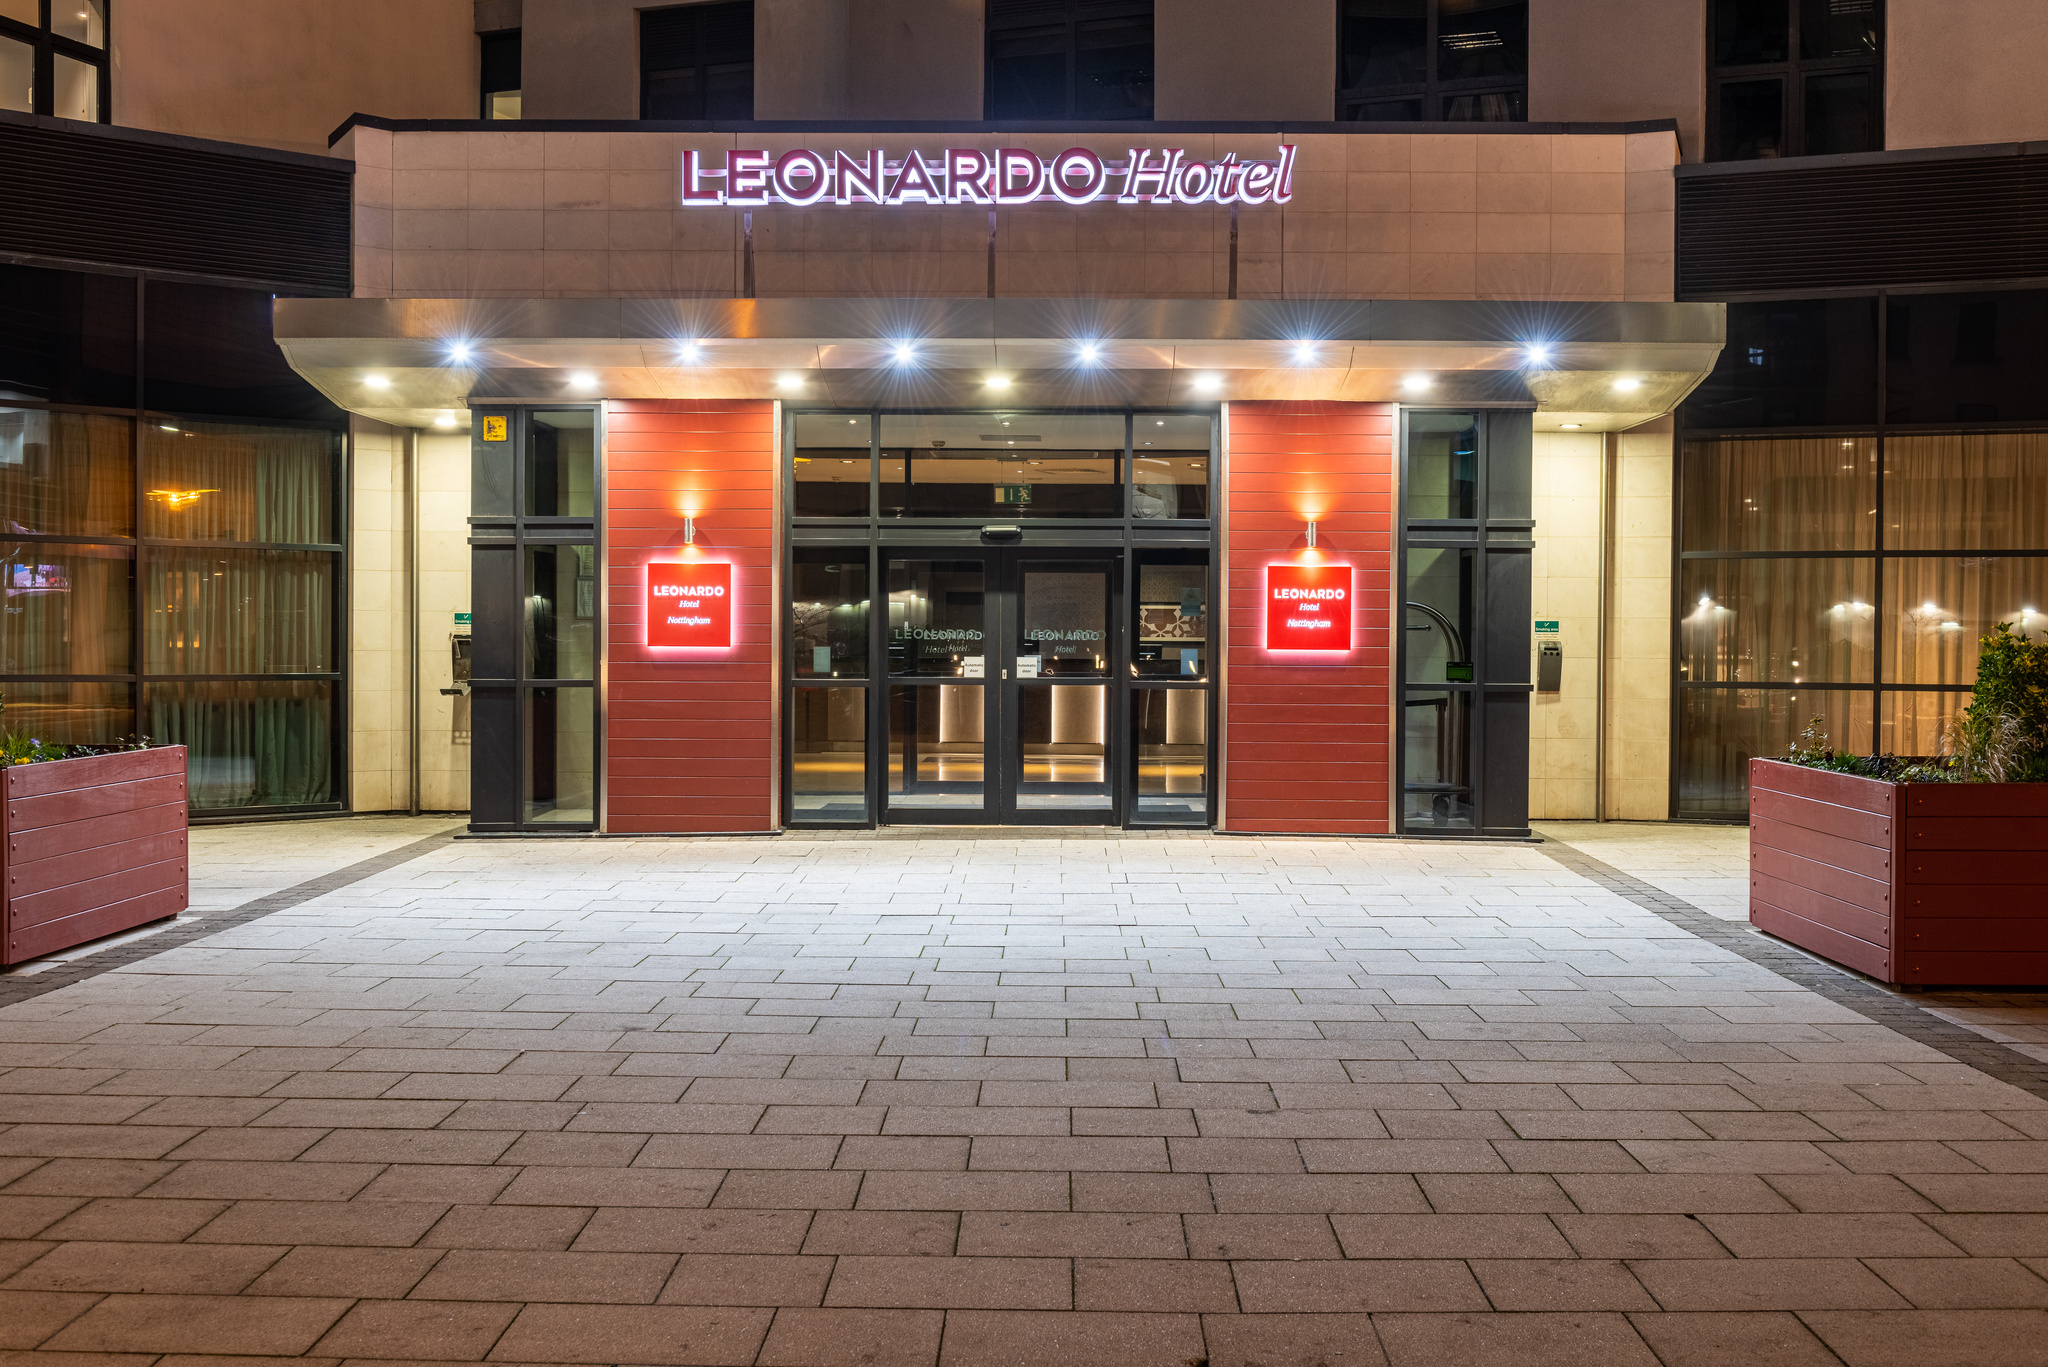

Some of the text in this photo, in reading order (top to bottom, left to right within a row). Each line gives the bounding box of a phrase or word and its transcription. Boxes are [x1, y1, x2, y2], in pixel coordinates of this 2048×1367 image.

[681, 144, 1297, 206] LEONARDO Hotel
[653, 585, 724, 596] LEONARDO
[1273, 588, 1345, 600] LEONARDO
[678, 600, 700, 608] Hotel
[1298, 603, 1320, 611] Hotel
[666, 616, 711, 626] Nottingham
[1286, 619, 1331, 629] Nottingham
